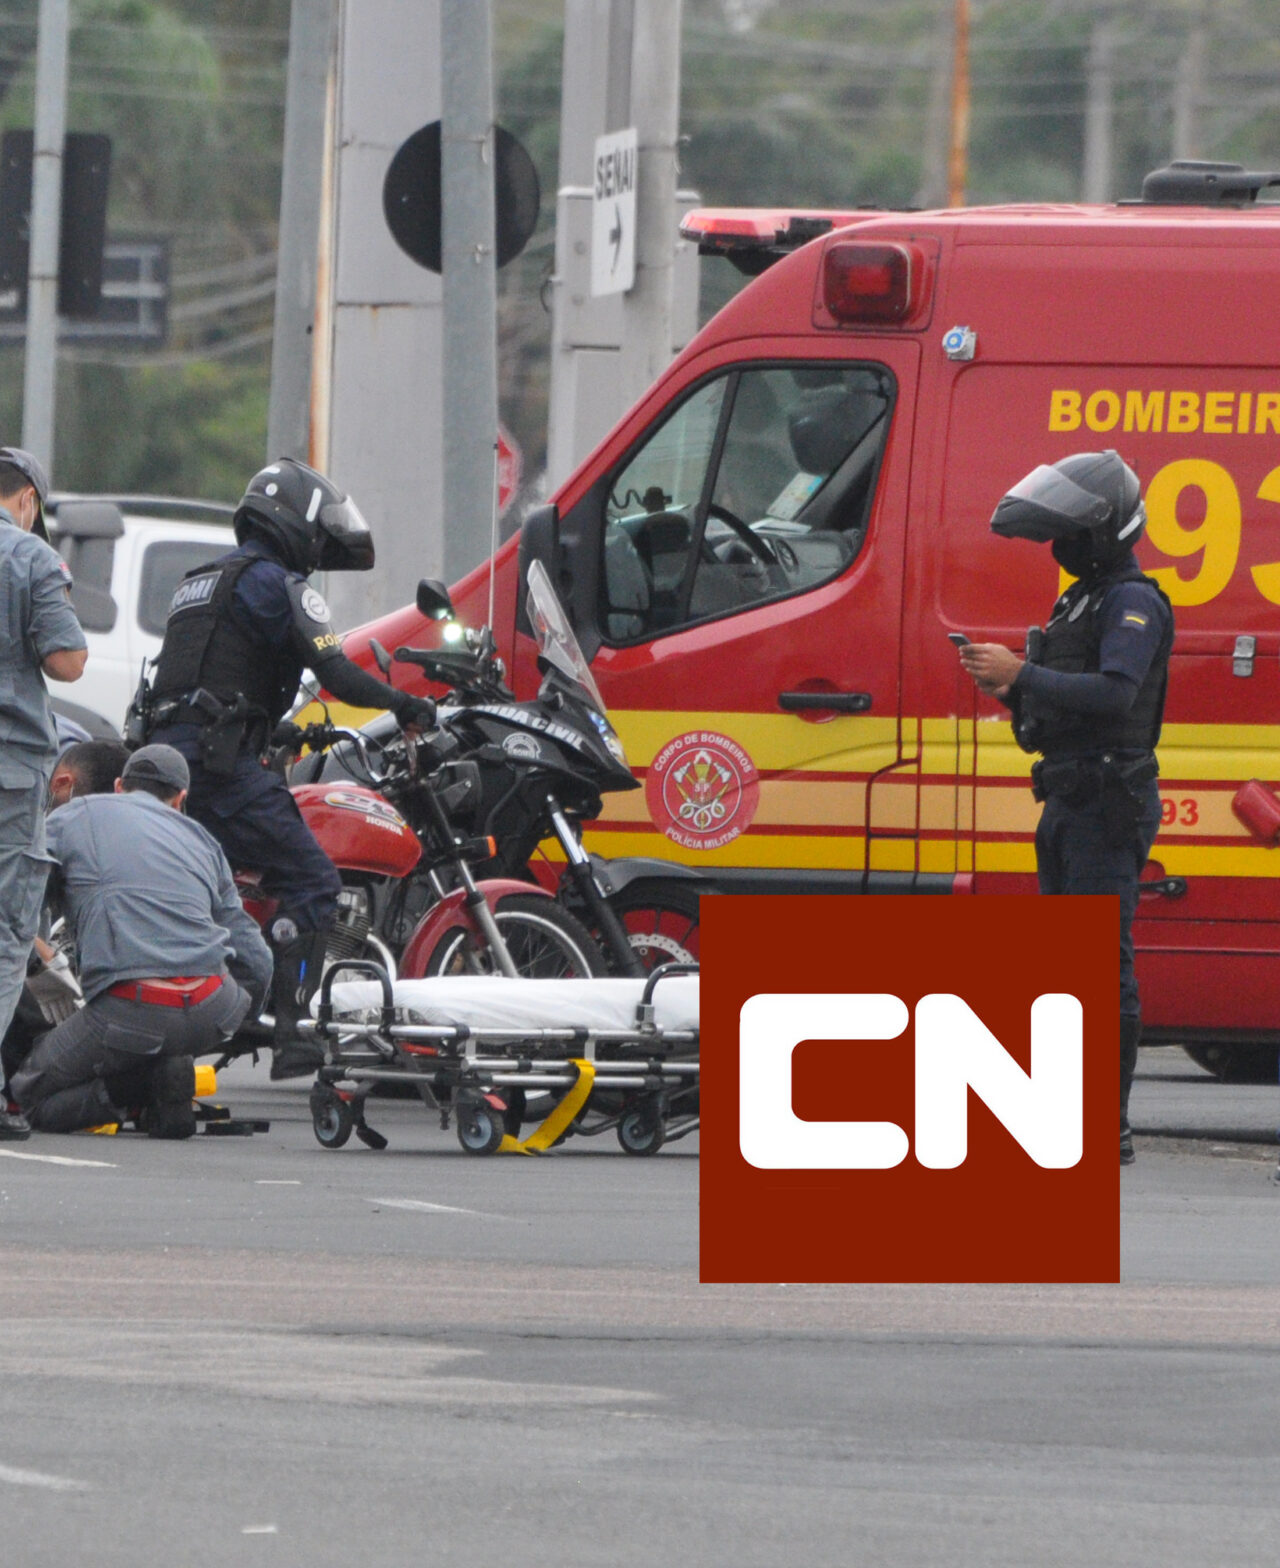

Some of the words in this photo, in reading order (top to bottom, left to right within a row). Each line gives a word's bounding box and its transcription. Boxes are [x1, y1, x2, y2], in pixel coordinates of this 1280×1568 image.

[596, 147, 634, 201] SENAI
[654, 739, 683, 772] CORPO
[684, 733, 698, 745] DE
[700, 732, 753, 773] BOMBEIROS
[365, 815, 404, 836] HONDA
[665, 826, 703, 849] POLÍCIA
[704, 826, 740, 849] MILITAR
